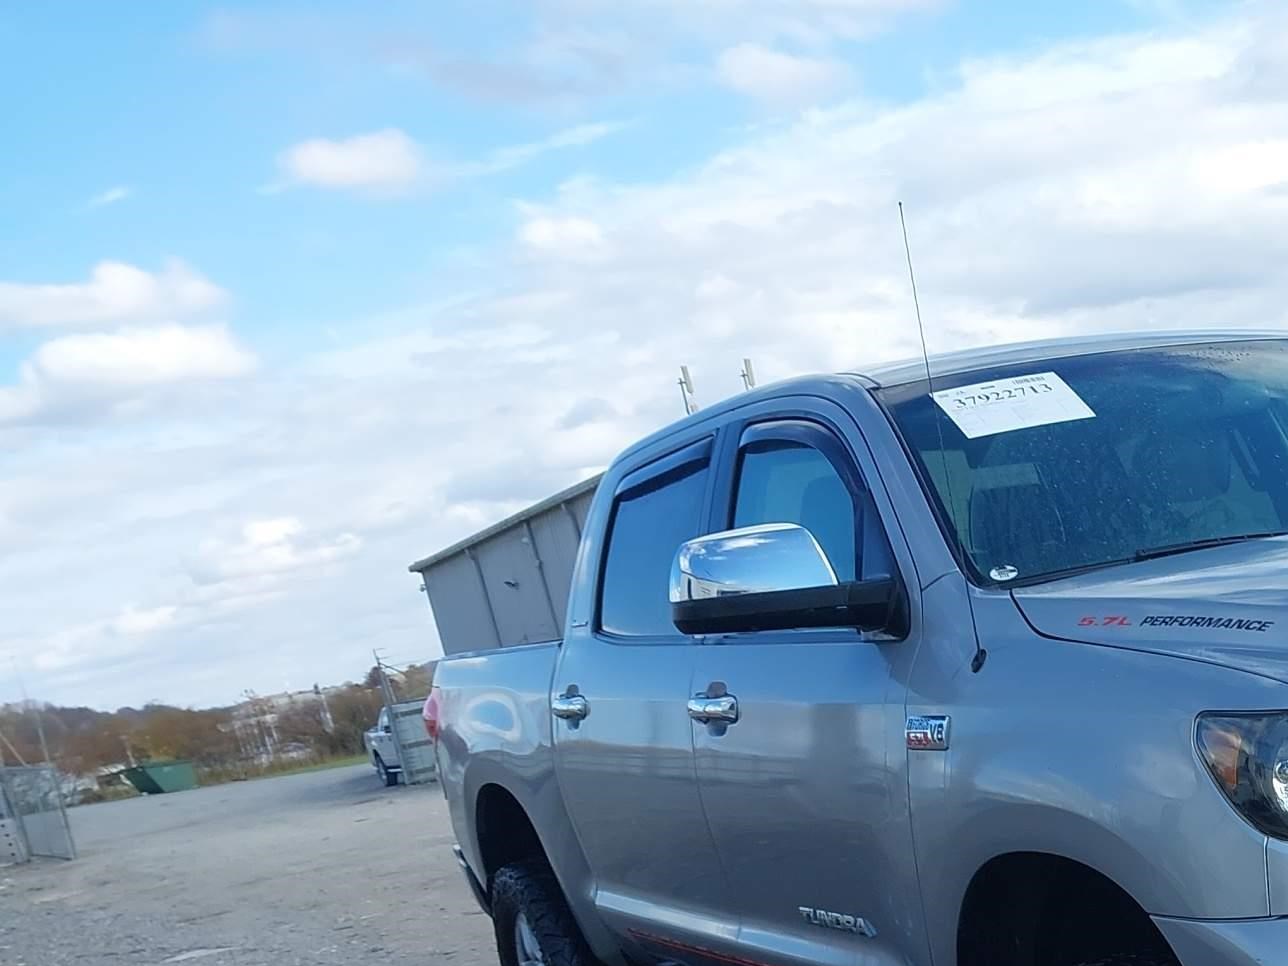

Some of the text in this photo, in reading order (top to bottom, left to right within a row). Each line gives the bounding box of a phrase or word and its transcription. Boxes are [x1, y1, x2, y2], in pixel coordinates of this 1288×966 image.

[953, 384, 1053, 408] 37922713
[1077, 615, 1275, 632] 5.7L PERFORMANCE
[929, 722, 944, 743] V8
[798, 906, 874, 937] TUNDRA
